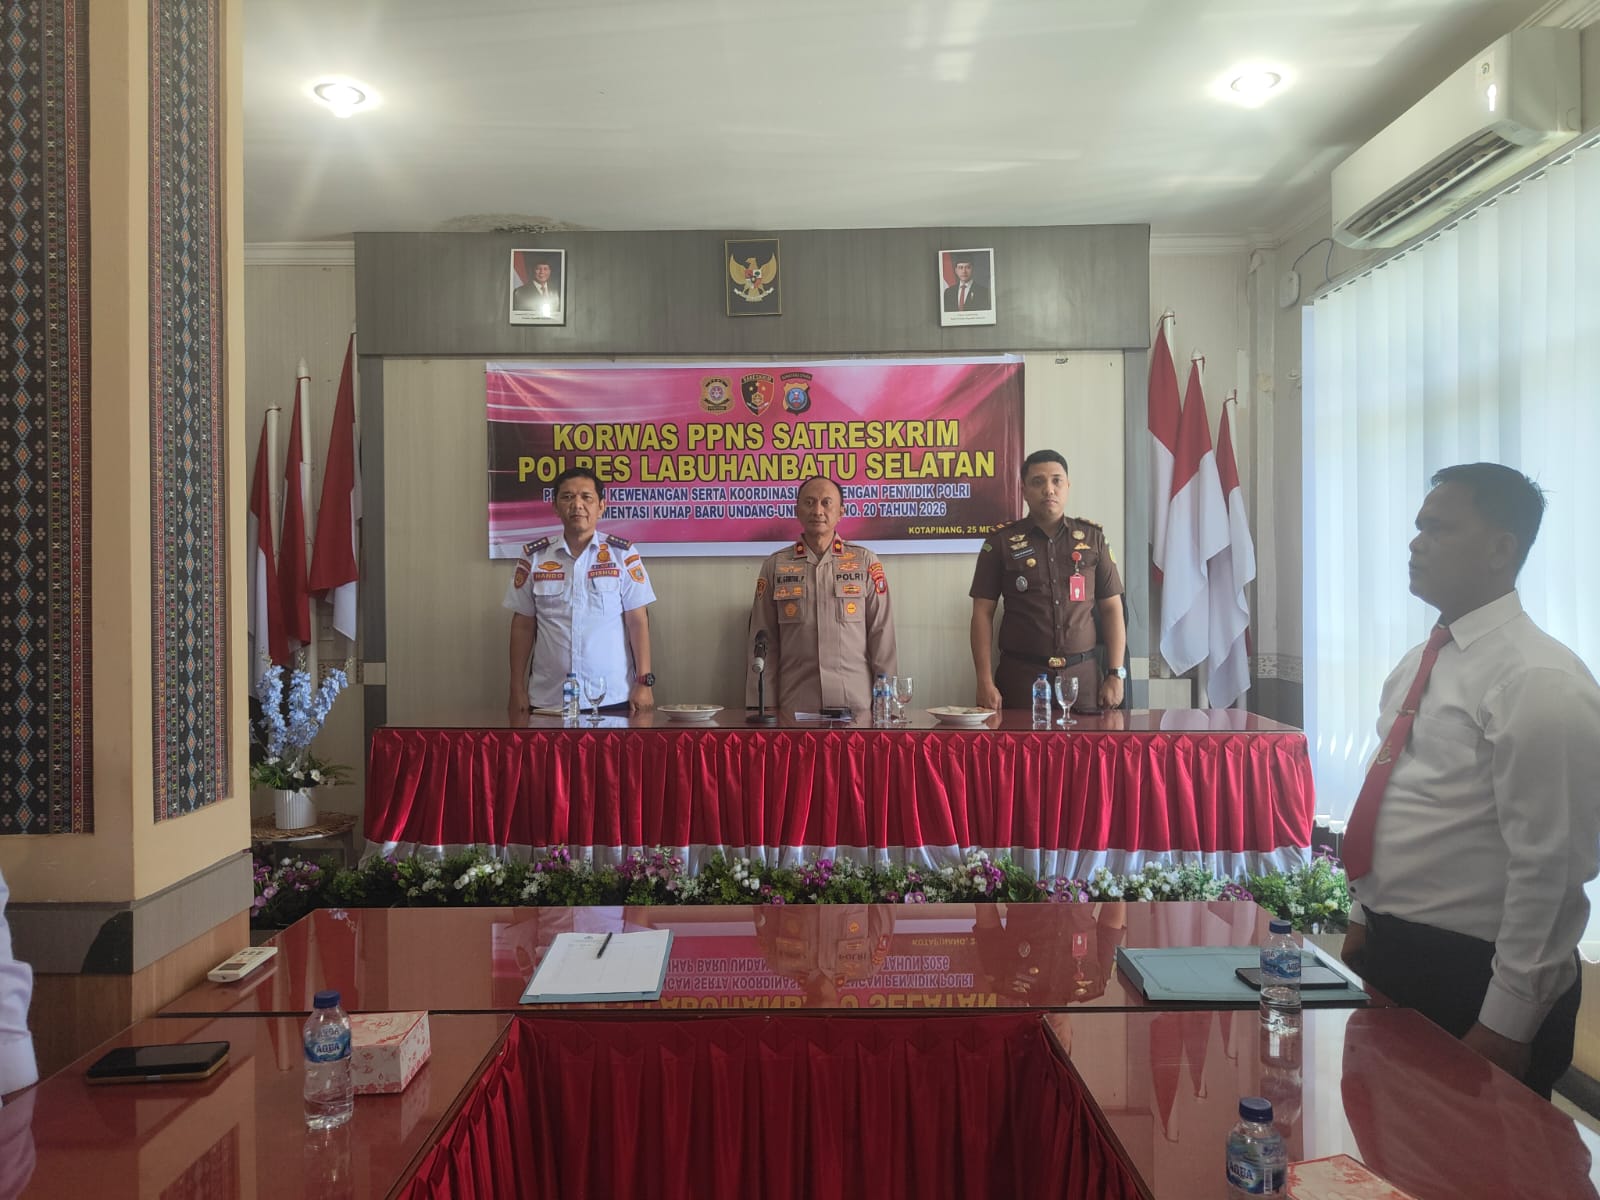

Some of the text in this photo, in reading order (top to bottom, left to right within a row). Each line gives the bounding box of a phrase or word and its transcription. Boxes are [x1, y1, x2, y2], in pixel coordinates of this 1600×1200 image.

[553, 420, 960, 451] KORWAS PPNS SATRESKRIM
[640, 452, 857, 482] LABUHANBATU
[865, 451, 995, 480] SELATAN
[609, 487, 688, 502] KEWENANGAN
[691, 487, 726, 502] SERTA
[841, 485, 878, 500] ENGAN
[881, 485, 936, 500] PENYIDIK
[937, 484, 970, 499] POLRI
[653, 505, 691, 520] KUHAP
[695, 505, 724, 519] BARU
[863, 502, 877, 517] 20
[879, 502, 918, 517] TAHUN
[919, 501, 946, 517] 2026
[908, 525, 965, 535] KOTAPINANG,
[967, 525, 978, 534] 25
[836, 573, 863, 582] POLRI
[316, 1042, 340, 1053] AQUA
[1228, 1161, 1254, 1181] AQUA
